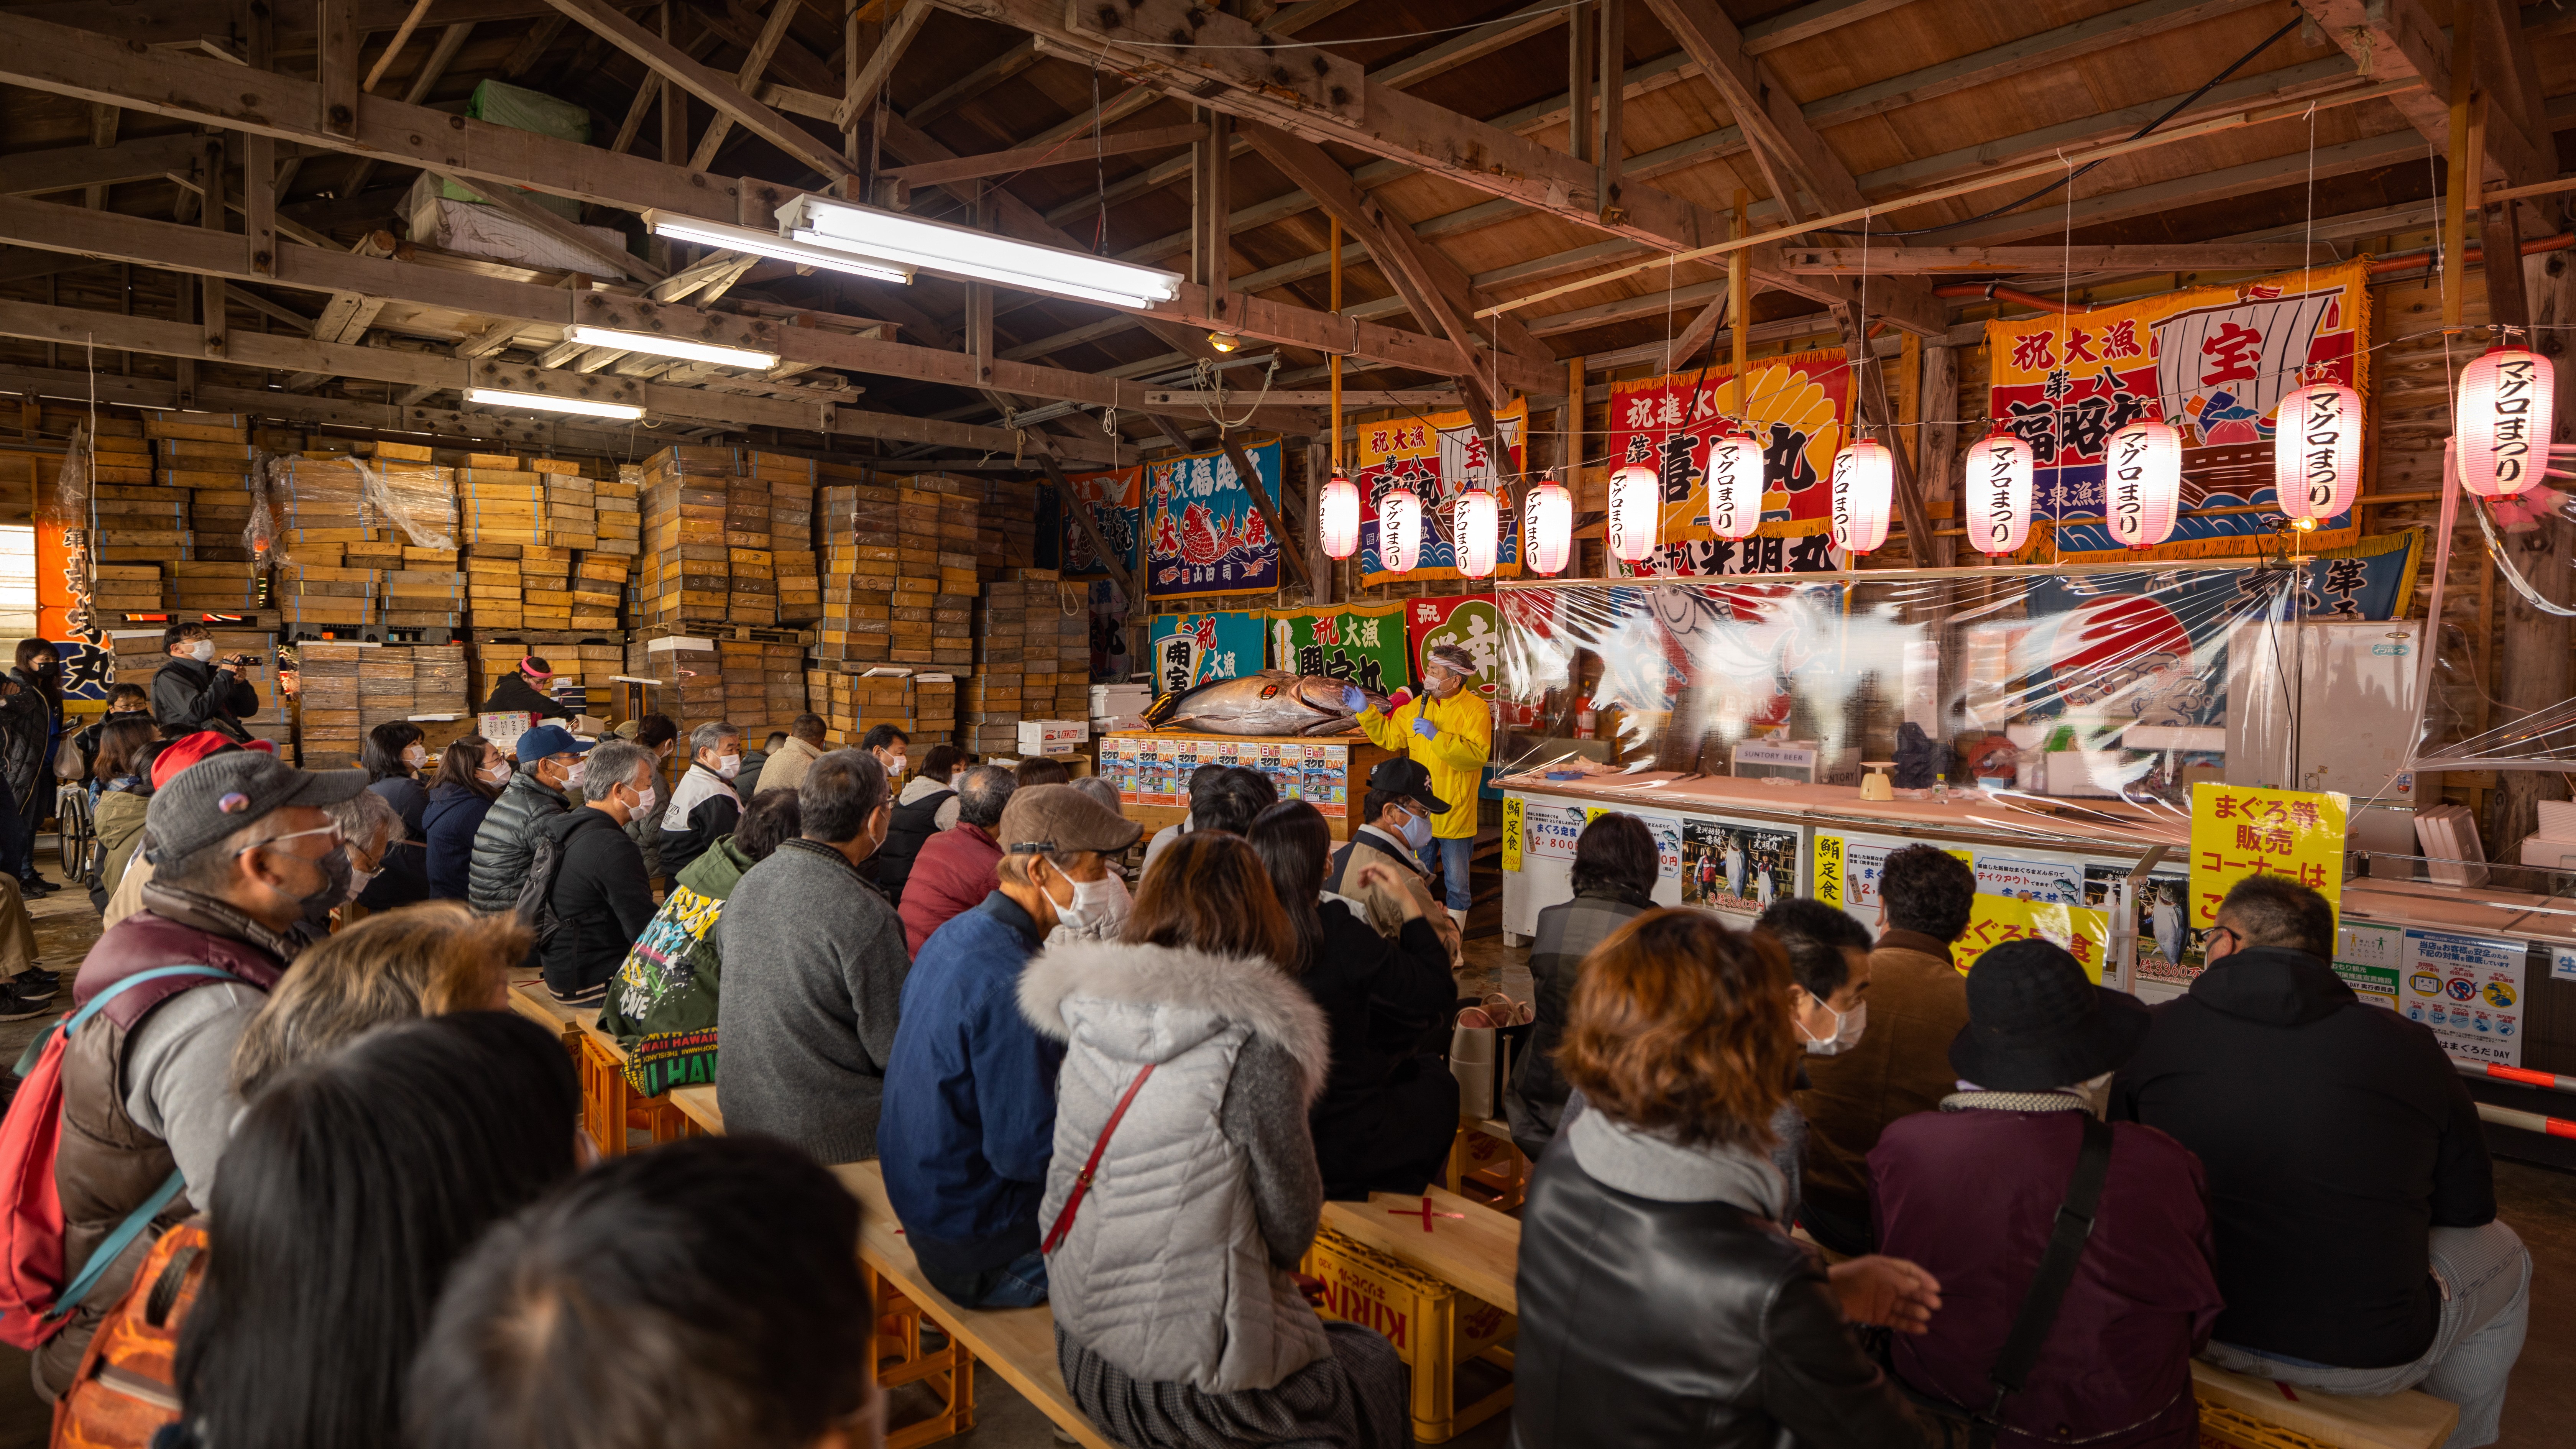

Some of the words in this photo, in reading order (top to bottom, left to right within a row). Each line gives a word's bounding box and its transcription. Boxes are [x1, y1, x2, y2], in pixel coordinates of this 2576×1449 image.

[2011, 319, 2143, 371] 祝大漁
[2201, 322, 2263, 388] 宝
[2044, 366, 2128, 400] 第八
[1626, 388, 1715, 429] 祝進水
[2490, 360, 2537, 482] マグロまつり
[1371, 426, 1426, 454] 祝大漁
[1464, 435, 1489, 470] 宝
[2306, 393, 2343, 506] マグロまつり
[1385, 454, 1424, 473] 第八
[1656, 422, 1818, 505] 喜丸
[1158, 475, 1168, 493] 祝
[1175, 461, 1188, 499] 第八
[1717, 445, 1739, 529] マグロまつり
[1989, 446, 2017, 543] マグロまつり
[2116, 432, 2148, 534] マグロまつり
[1611, 475, 1630, 549] マグロまつり
[1834, 453, 1852, 544] マグロまつり
[1157, 516, 1178, 555] 大
[1386, 499, 1403, 567] マグロまつり
[1456, 500, 1470, 569] マグロまつり
[1527, 491, 1541, 565] マグロまつり
[1640, 541, 1697, 571] 二十八
[1417, 604, 1441, 624] 祝
[1196, 616, 1217, 651] 祝
[1311, 616, 1340, 647] 祝
[1342, 616, 1381, 648] 大漁
[1210, 651, 1236, 678] 大漁
[1101, 751, 1119, 759] マグロ
[1120, 751, 1136, 760] DAY
[1139, 752, 1157, 761] マグロ
[1158, 753, 1175, 762] DAY
[1178, 754, 1198, 763] マグロ
[1198, 754, 1214, 764] DAY
[1218, 756, 1238, 765] マグロ
[1239, 756, 1257, 766] DAY
[1260, 757, 1281, 767] マグロ
[1281, 757, 1300, 767] DAY
[1304, 759, 1325, 768] マグロ
[1325, 759, 1345, 769] DAY
[1744, 750, 1779, 760] SUNTORY
[1819, 772, 1855, 784] SNTORY
[1506, 800, 1520, 851] 鮪定食
[2215, 794, 2320, 829] まぐろ等
[1537, 823, 1577, 838] まぐろ定食
[1753, 840, 1779, 852] 光明丸
[2235, 824, 2294, 856] 販売
[1503, 855, 1520, 865] 2800
[1818, 838, 1840, 900] 鮪定食
[1977, 863, 2065, 878] 解体した新鮮なまぐろをどんぶりで
[2201, 851, 2327, 889] コーナーは
[1708, 892, 1765, 912] 3億3360万円
[2417, 948, 2510, 968] 下記の対策を徹底しています
[2419, 940, 2509, 960] 当店はお客様の安全のため
[2135, 958, 2200, 979] 億3360万
[2361, 984, 2394, 993] 実行委員会
[672, 1033, 718, 1048] HAWAII
[2494, 1050, 2510, 1059] DAY
[1319, 1273, 1407, 1350] KIRIN
